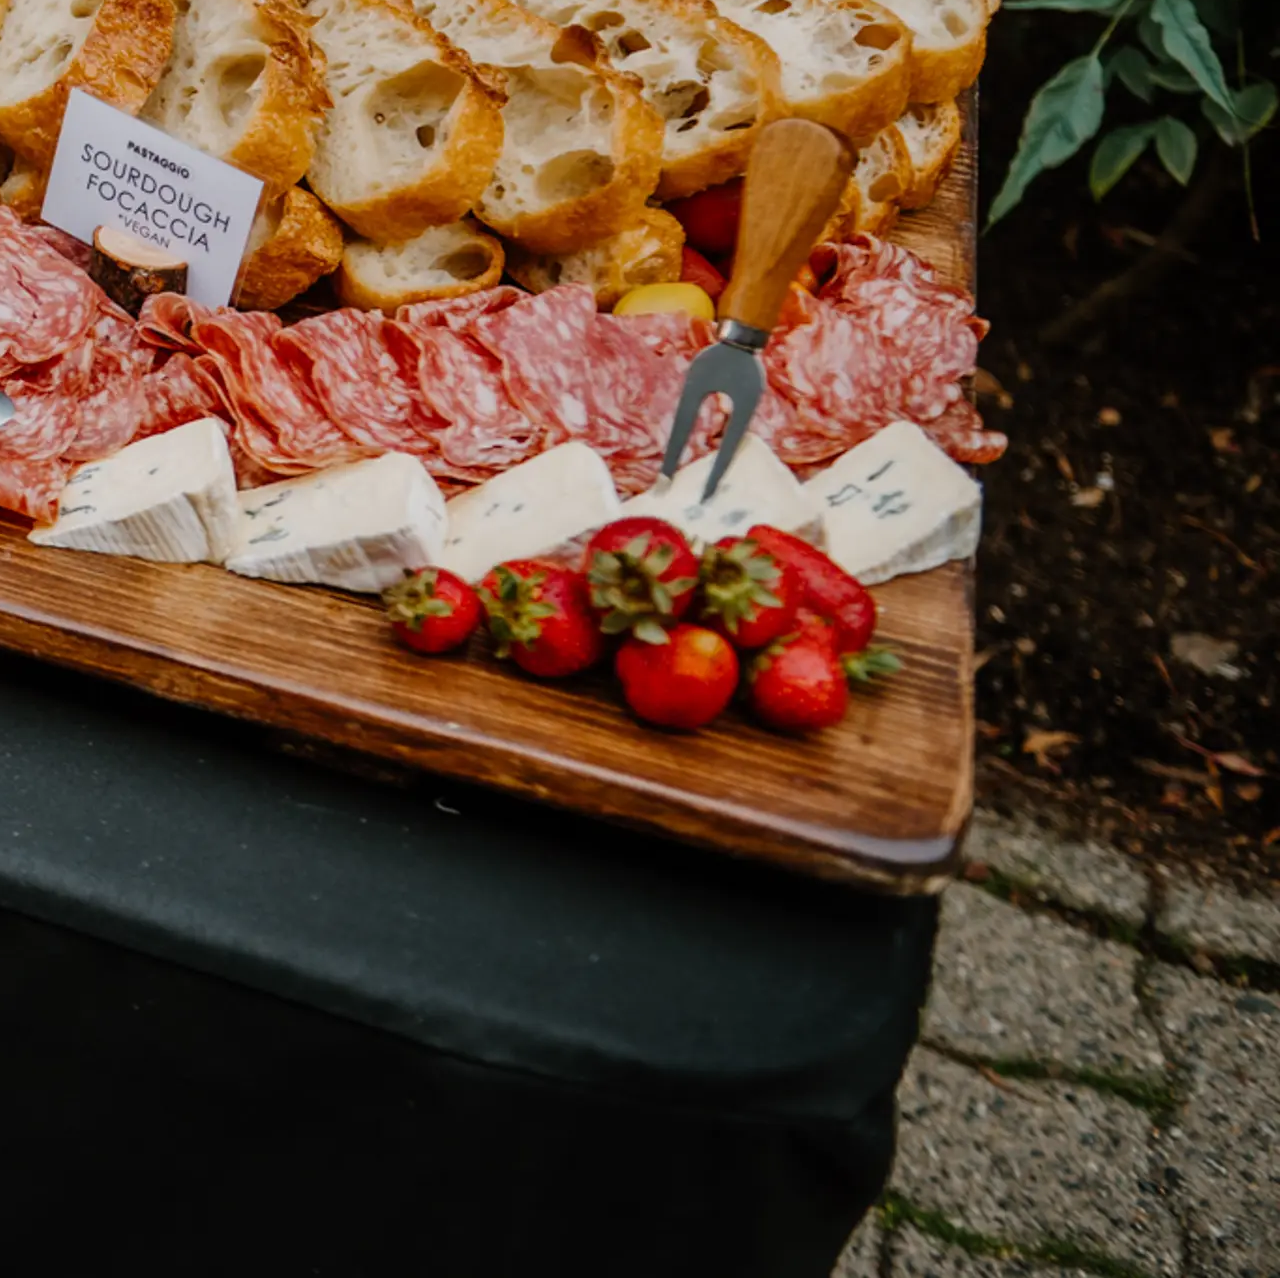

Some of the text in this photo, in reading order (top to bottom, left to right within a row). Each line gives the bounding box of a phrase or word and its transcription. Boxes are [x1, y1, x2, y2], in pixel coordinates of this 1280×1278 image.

[80, 143, 232, 233] SOURDOUGH
[126, 140, 191, 180] PASTAGGIO
[86, 173, 210, 253] FOCACCIA
